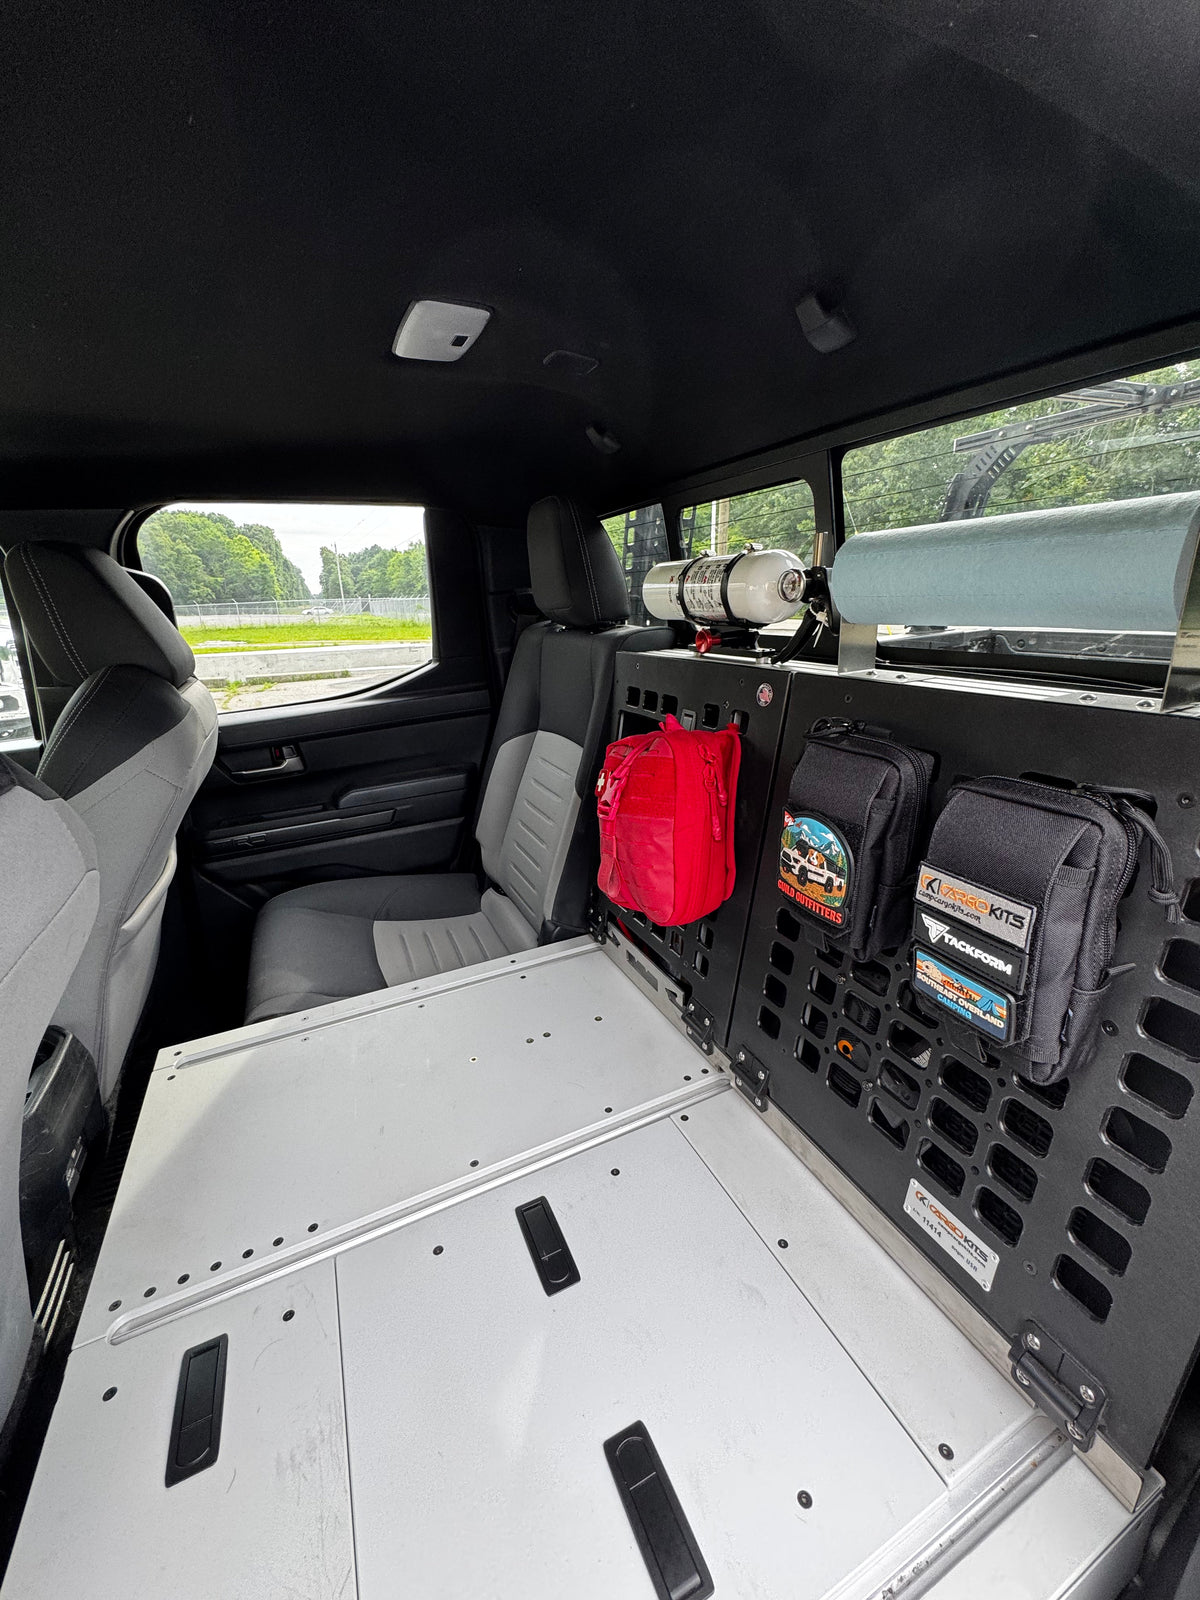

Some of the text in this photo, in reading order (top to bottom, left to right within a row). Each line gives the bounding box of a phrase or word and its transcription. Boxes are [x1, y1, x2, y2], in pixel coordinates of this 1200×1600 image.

[778, 879, 842, 924] GUILD OUTFITTERS
[942, 933, 1013, 975] TACKFORM
[916, 971, 1005, 1029] SOUTHEAST OVERLAND
[936, 994, 972, 1020] CAMPING
[922, 1216, 942, 1238] 11414
